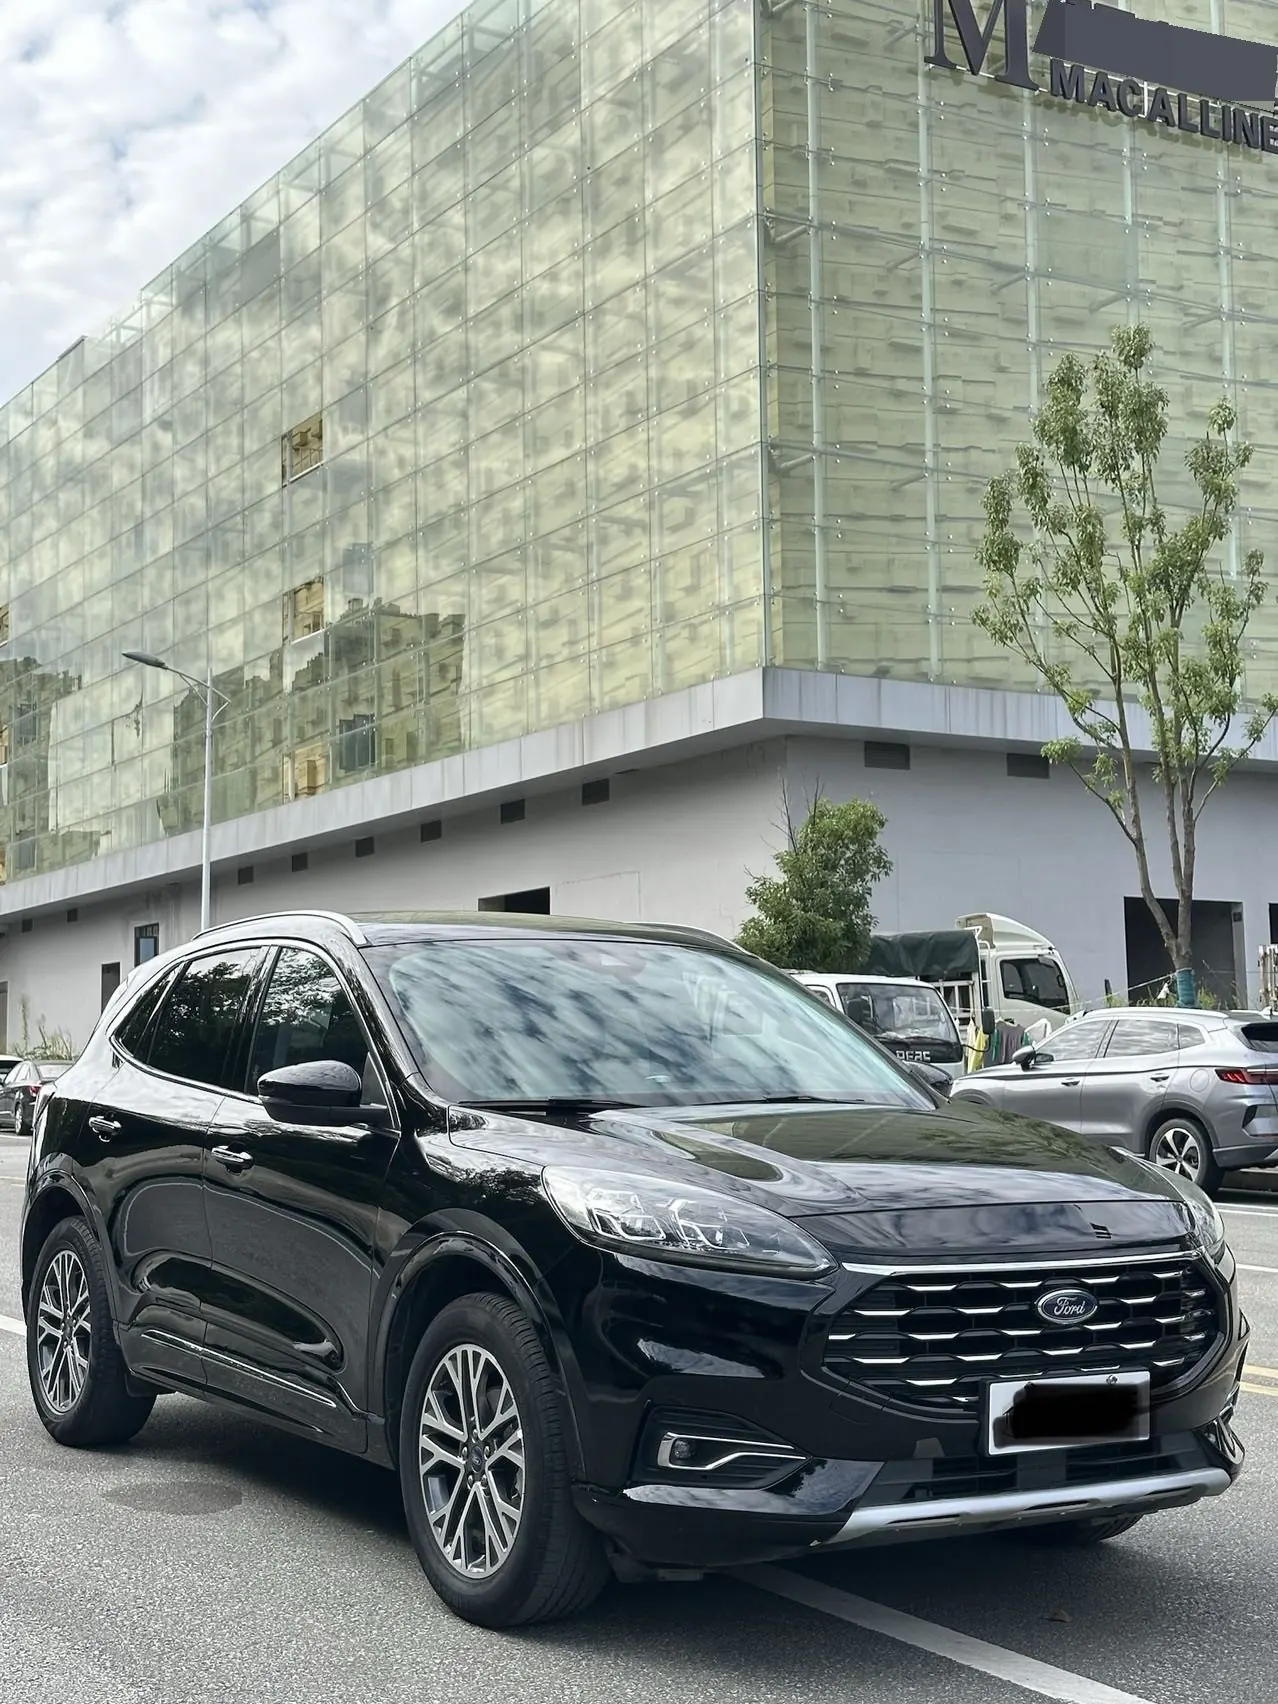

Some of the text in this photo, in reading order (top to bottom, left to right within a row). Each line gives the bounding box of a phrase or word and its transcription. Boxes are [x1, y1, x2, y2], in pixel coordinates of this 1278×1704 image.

[924, 0, 1040, 91] M
[1050, 58, 1278, 154] MACALLINE
[1053, 1296, 1086, 1316] Ford
